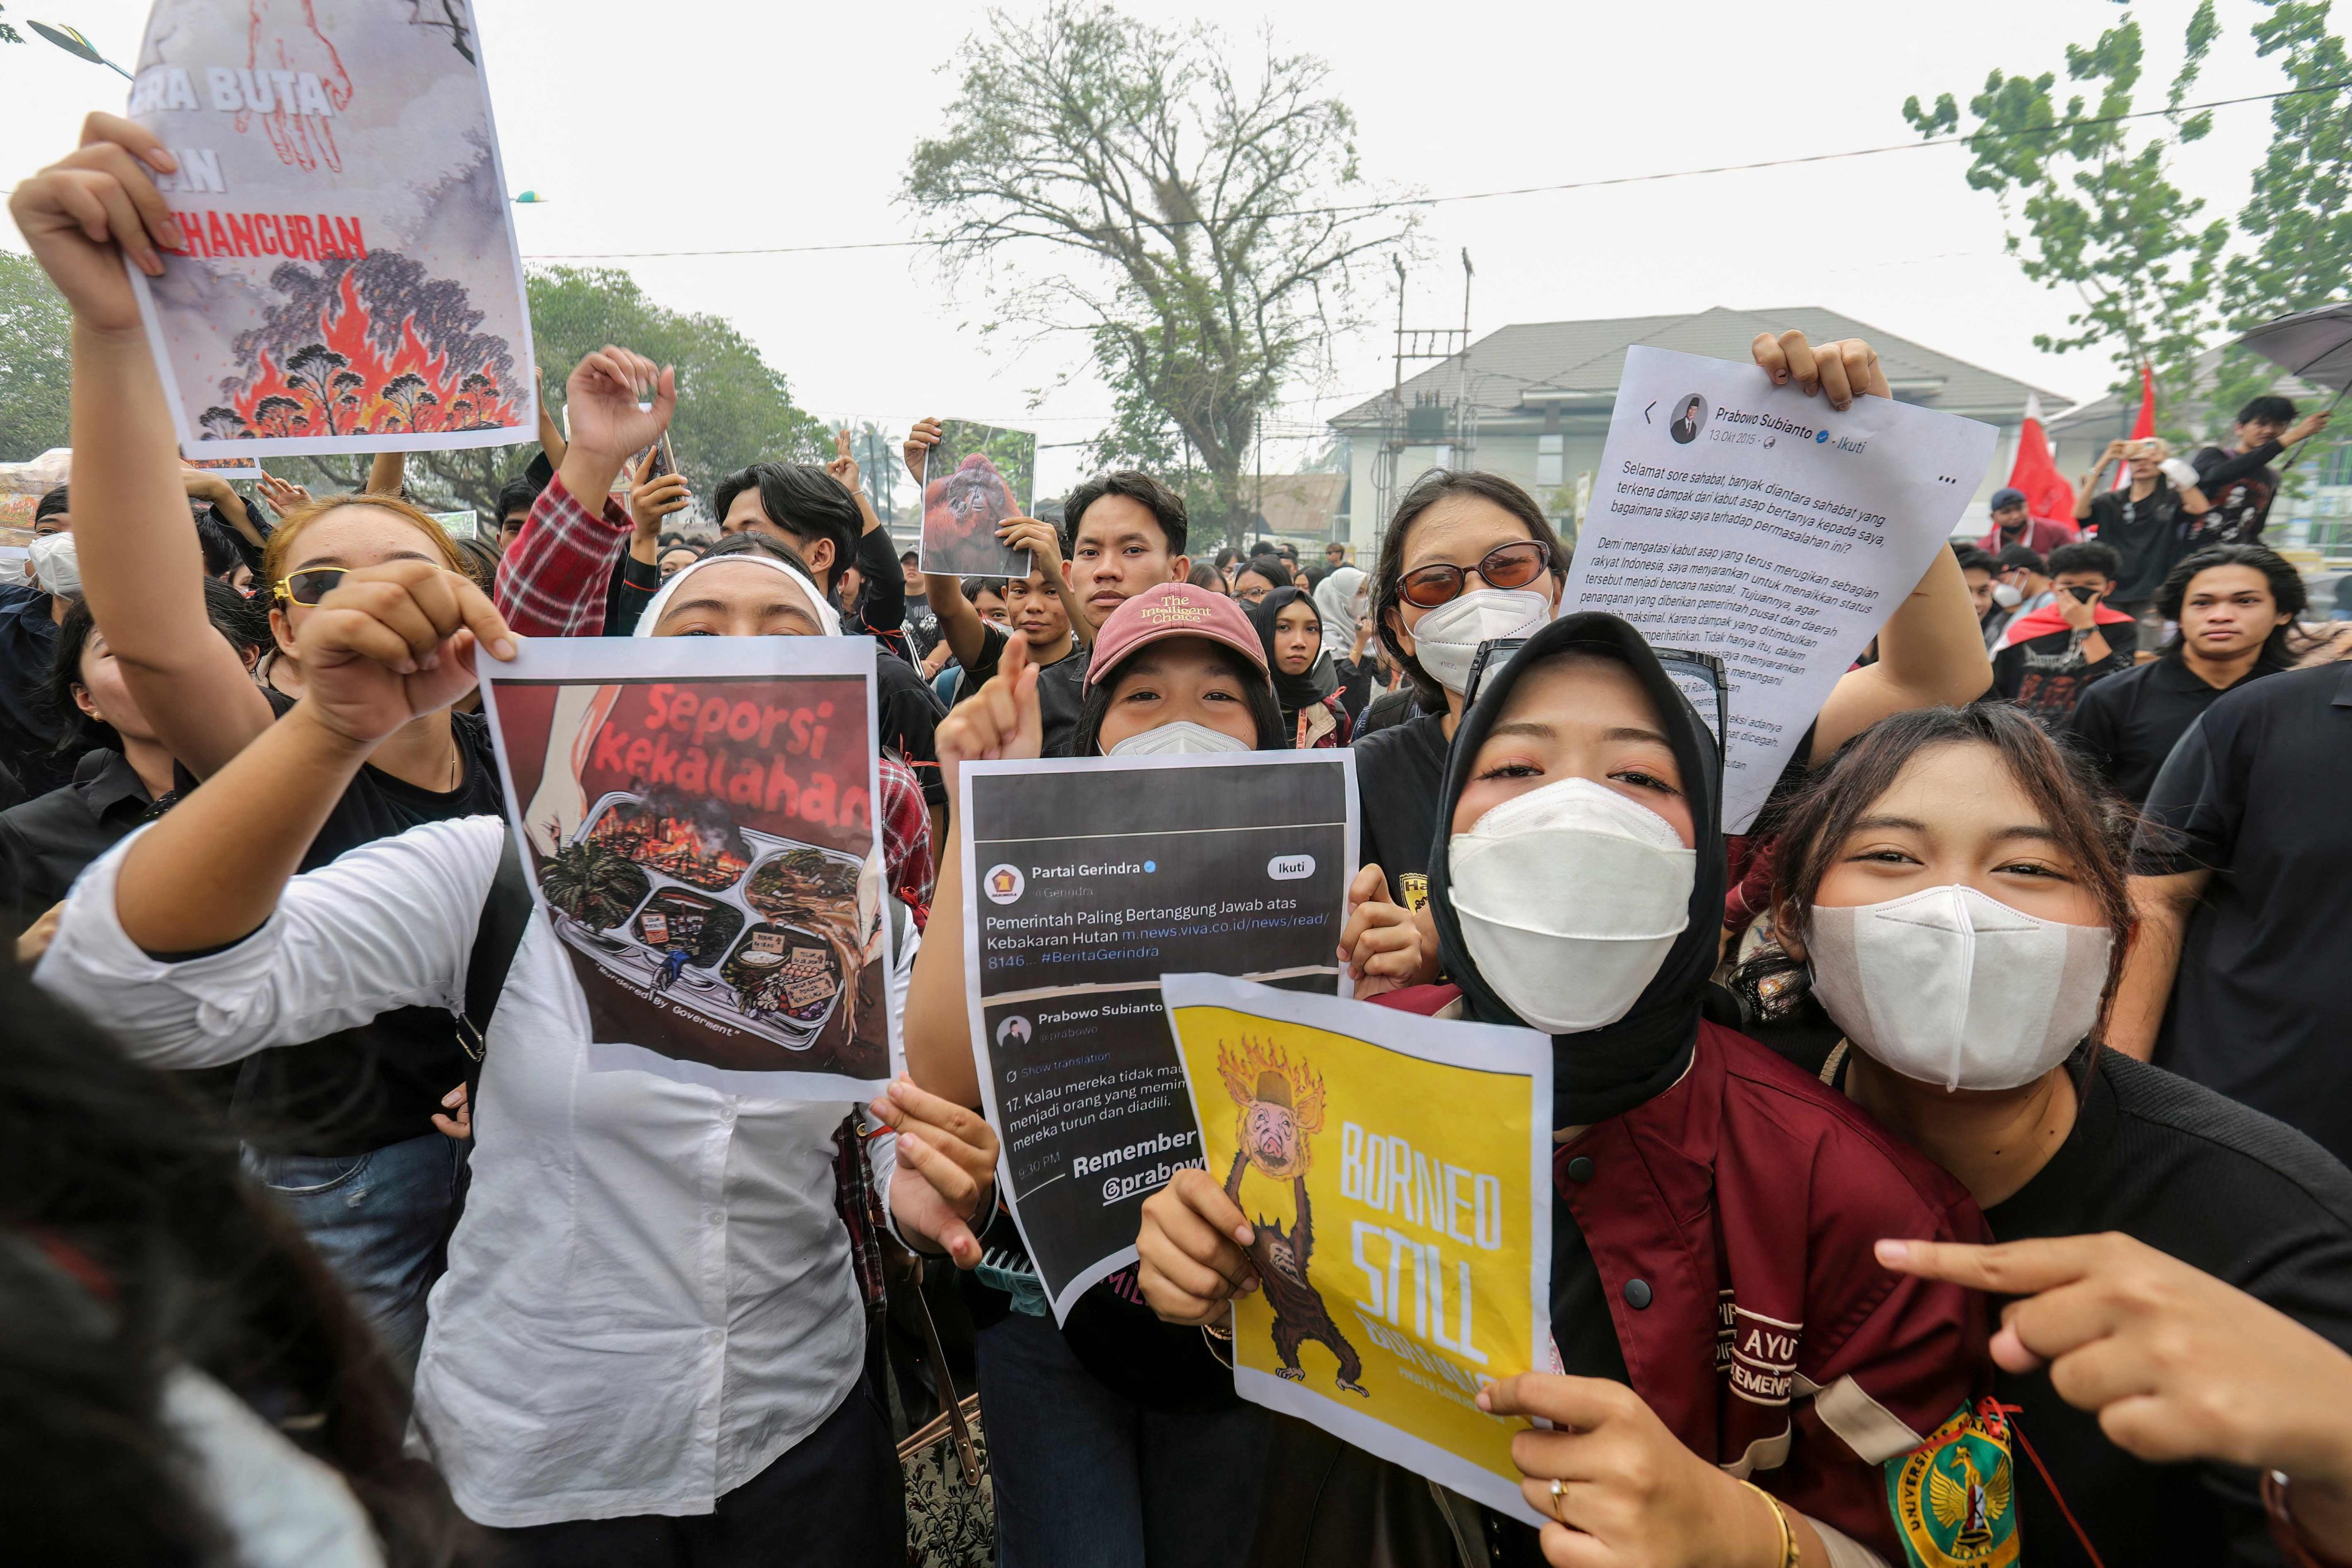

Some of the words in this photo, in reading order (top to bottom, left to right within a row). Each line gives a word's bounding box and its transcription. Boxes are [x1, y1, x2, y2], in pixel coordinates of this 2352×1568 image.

[207, 67, 333, 116] BUTA
[1709, 430, 1719, 441] 13
[1721, 430, 1735, 443] Okt
[1736, 432, 1755, 444] 2015
[1714, 407, 1759, 424] Prabowo
[1760, 414, 1812, 439] Subianto
[1837, 437, 1867, 454] Ikuti
[1623, 461, 1666, 478] Selamat
[1667, 470, 1689, 481] sore
[1690, 472, 1725, 487] sahabat,
[1728, 474, 1764, 492] banyak
[1766, 483, 1811, 505] diantara
[1813, 499, 1857, 518] sahabat
[1856, 511, 1886, 527] yang
[1611, 500, 1663, 517] bagaimana
[1664, 507, 1689, 522] sikap
[1689, 512, 1710, 523] saya
[1711, 511, 1752, 528] terhadap
[1753, 520, 1830, 550] permasalahan
[1830, 540, 1852, 554] ini?
[1617, 481, 1655, 497] terkena
[1657, 486, 1694, 502] dampak
[1695, 491, 1714, 503] dari
[1714, 492, 1739, 506] kabut
[1739, 497, 1766, 511] asap
[1767, 502, 1815, 527] bertanya
[1817, 517, 1857, 537] kepada
[1857, 530, 1884, 548] saya,
[1590, 555, 1619, 569] rakyat
[1620, 557, 1664, 573] Indonesia,
[1667, 562, 1688, 574] saya
[1689, 564, 1749, 581] menyarankan
[1751, 574, 1781, 590] untuk
[1782, 584, 1838, 606] menaikkan
[1839, 599, 1872, 614] status
[1598, 537, 1623, 550] Demi
[1623, 539, 1672, 554] mengatasi
[1671, 543, 1697, 557] kabut
[1697, 547, 1718, 560] asap
[1718, 549, 1743, 563] yang
[1745, 553, 1773, 570] terus
[1774, 564, 1829, 586] merugikan
[1830, 578, 1879, 600] sebagian
[1161, 594, 1189, 607] The
[1585, 573, 1623, 586] tersebut
[1624, 576, 1660, 590] menjadi
[1659, 577, 1697, 591] bencana
[1697, 581, 1735, 594] nasional.
[1740, 587, 1791, 611] Tujuannya,
[1794, 604, 1820, 616] agar
[1141, 606, 1212, 619] Intelligent
[1152, 613, 1201, 624] Choice
[1580, 592, 1633, 605] penanganan
[1636, 596, 1657, 608] yang
[1658, 595, 1697, 608] diberikan
[1697, 599, 1748, 615] pemerintah
[1749, 608, 1781, 622] pusat
[1781, 615, 1801, 628] dan
[1802, 620, 1838, 638] daerah
[1625, 612, 1666, 623] maksimal.
[1668, 612, 1696, 624] Karena
[1698, 614, 1732, 627] dampak
[1732, 620, 1759, 634] yang
[1759, 625, 1818, 648] ditimbulkan
[1704, 631, 1725, 643] Tidak
[1725, 632, 1756, 648] hanya
[1756, 640, 1772, 654] itu,
[1775, 647, 1806, 661] dalam
[1721, 650, 1739, 661] saya
[1741, 654, 1806, 675] menyarankan
[1730, 667, 1785, 686] menangani
[1740, 731, 1779, 747] dicegah.
[1748, 718, 1783, 733] adanya
[1032, 864, 1075, 879] Partai
[1079, 862, 1141, 876] Gerindra
[1279, 862, 1305, 874] Ikuti
[986, 912, 1073, 930] Pemerintah
[1077, 910, 1123, 925] Paling
[1126, 902, 1217, 922] Bertanggung
[1219, 898, 1263, 913] Jawab
[1267, 898, 1297, 910] atas
[987, 935, 1068, 949] Kebakaran
[1073, 930, 1118, 944] Hutan
[1042, 947, 1159, 964] #BeritaGerindra
[1038, 1009, 1098, 1025] Prabowo
[1102, 1002, 1163, 1016] Subianto
[1022, 1064, 1052, 1078] Show
[1054, 1052, 1111, 1069] translation
[1006, 1098, 1021, 1113] 17.
[1025, 1086, 1061, 1107] Kalau
[1065, 1074, 1115, 1095] mereka
[1119, 1067, 1153, 1083] tidak
[1010, 1102, 1060, 1133] menjadi
[1063, 1093, 1102, 1113] orang
[1105, 1086, 1137, 1105] yang
[1013, 1123, 1058, 1152] mereka
[1061, 1114, 1095, 1133] turun
[1099, 1105, 1124, 1121] dan
[1128, 1095, 1171, 1113] diadili.
[1044, 1150, 1060, 1168] PM
[1073, 1130, 1198, 1179] Remember
[1341, 1121, 1502, 1250] BORNEO
[1351, 1219, 1488, 1365] STILL
[1744, 1328, 1798, 1361] AYU
